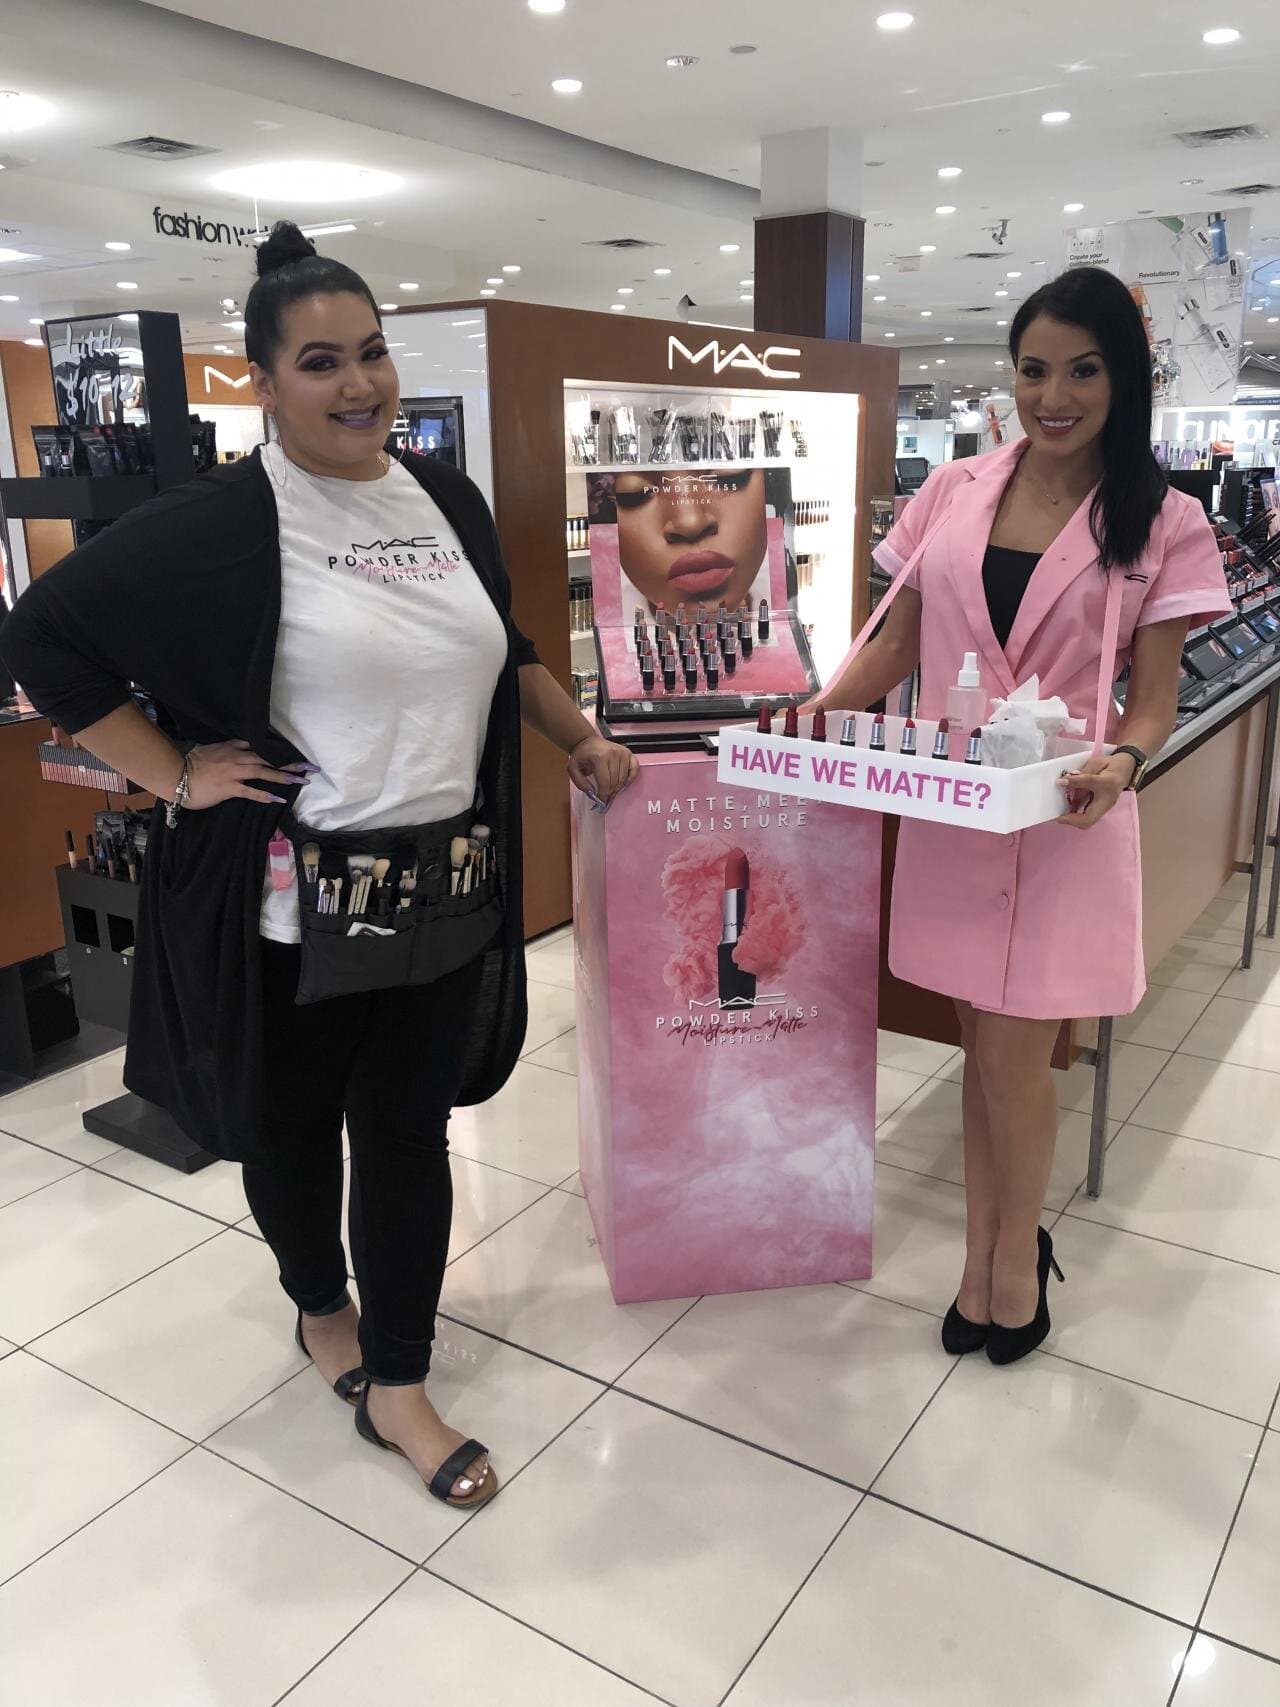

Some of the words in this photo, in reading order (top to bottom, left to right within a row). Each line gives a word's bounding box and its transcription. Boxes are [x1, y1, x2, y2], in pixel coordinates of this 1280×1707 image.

[152, 206, 231, 245] fashion
[396, 435, 436, 450] KISS
[643, 484, 699, 494] POWDER
[708, 483, 738, 491] KISS
[328, 553, 419, 570] POWDER
[730, 744, 801, 779] HAVE
[811, 756, 857, 788] WE
[866, 766, 992, 810] MATTE?
[666, 812, 808, 833] MOISTURE
[656, 1012, 752, 1029] POWDER
[769, 1006, 819, 1021] KISS
[667, 1021, 754, 1047] Moisture
[758, 1014, 809, 1039] Matte
[704, 1033, 774, 1047] LIPSTICK
